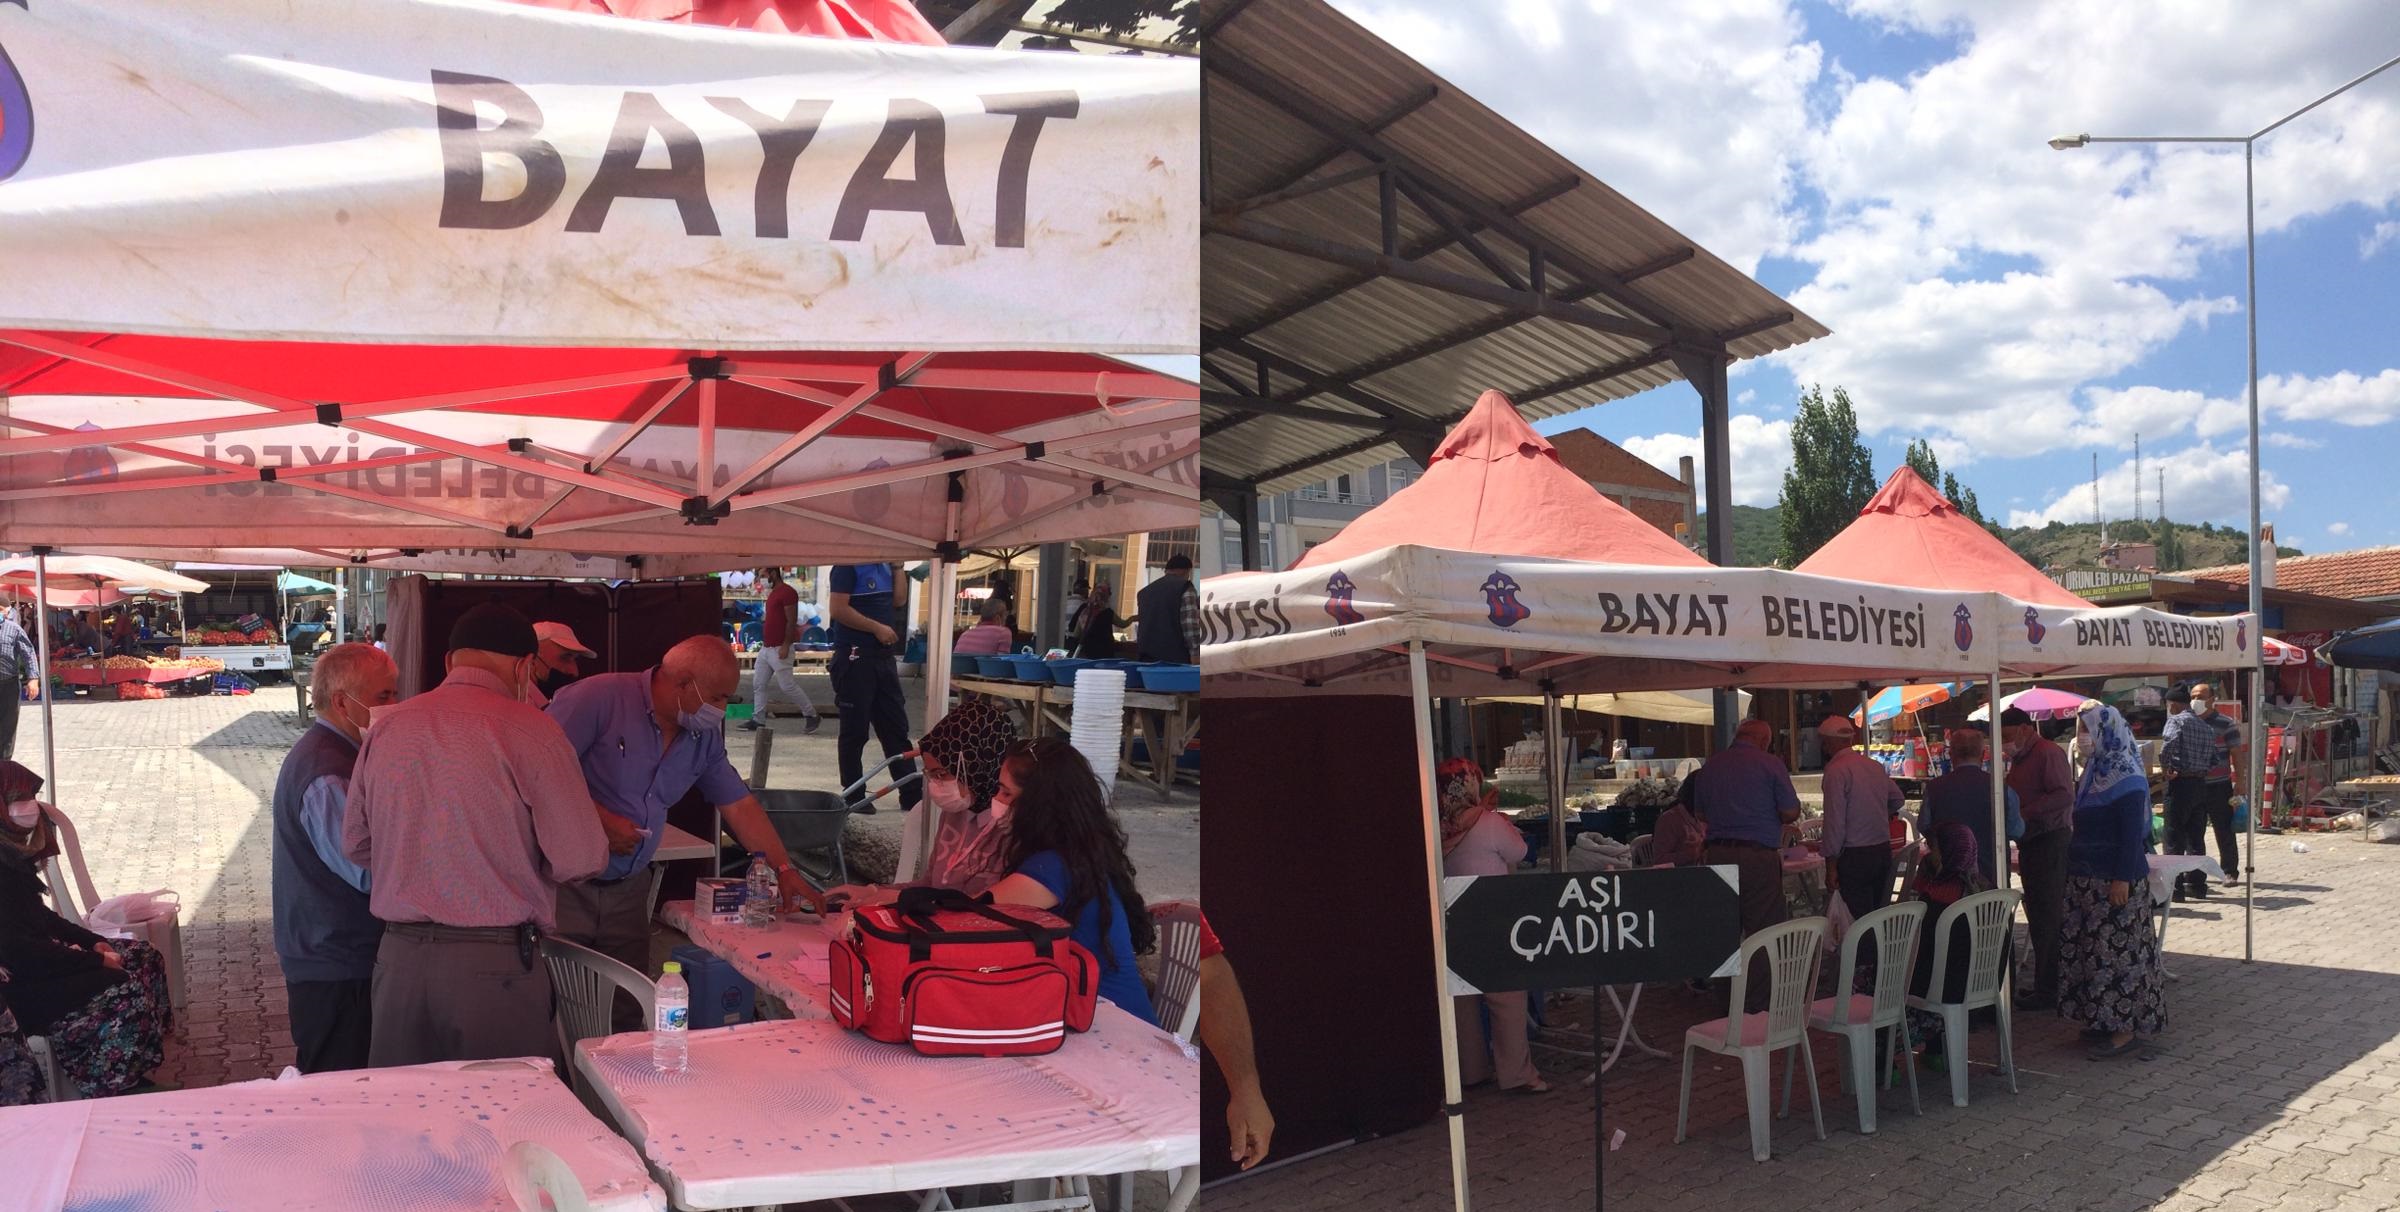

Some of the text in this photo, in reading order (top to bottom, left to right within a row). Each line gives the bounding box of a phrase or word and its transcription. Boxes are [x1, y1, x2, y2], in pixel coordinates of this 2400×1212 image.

[431, 68, 1081, 249] BAYAT
[2065, 568, 2110, 590] ÜRÜNLERİ
[1598, 592, 1925, 648] BAYAT BELEDİYESİ
[2074, 618, 2224, 651] BAYAT BELEDİYESİ
[2063, 707, 2078, 718] Gol
[1558, 874, 1621, 912] AŞI
[1510, 909, 1655, 962] ÇADIRI
